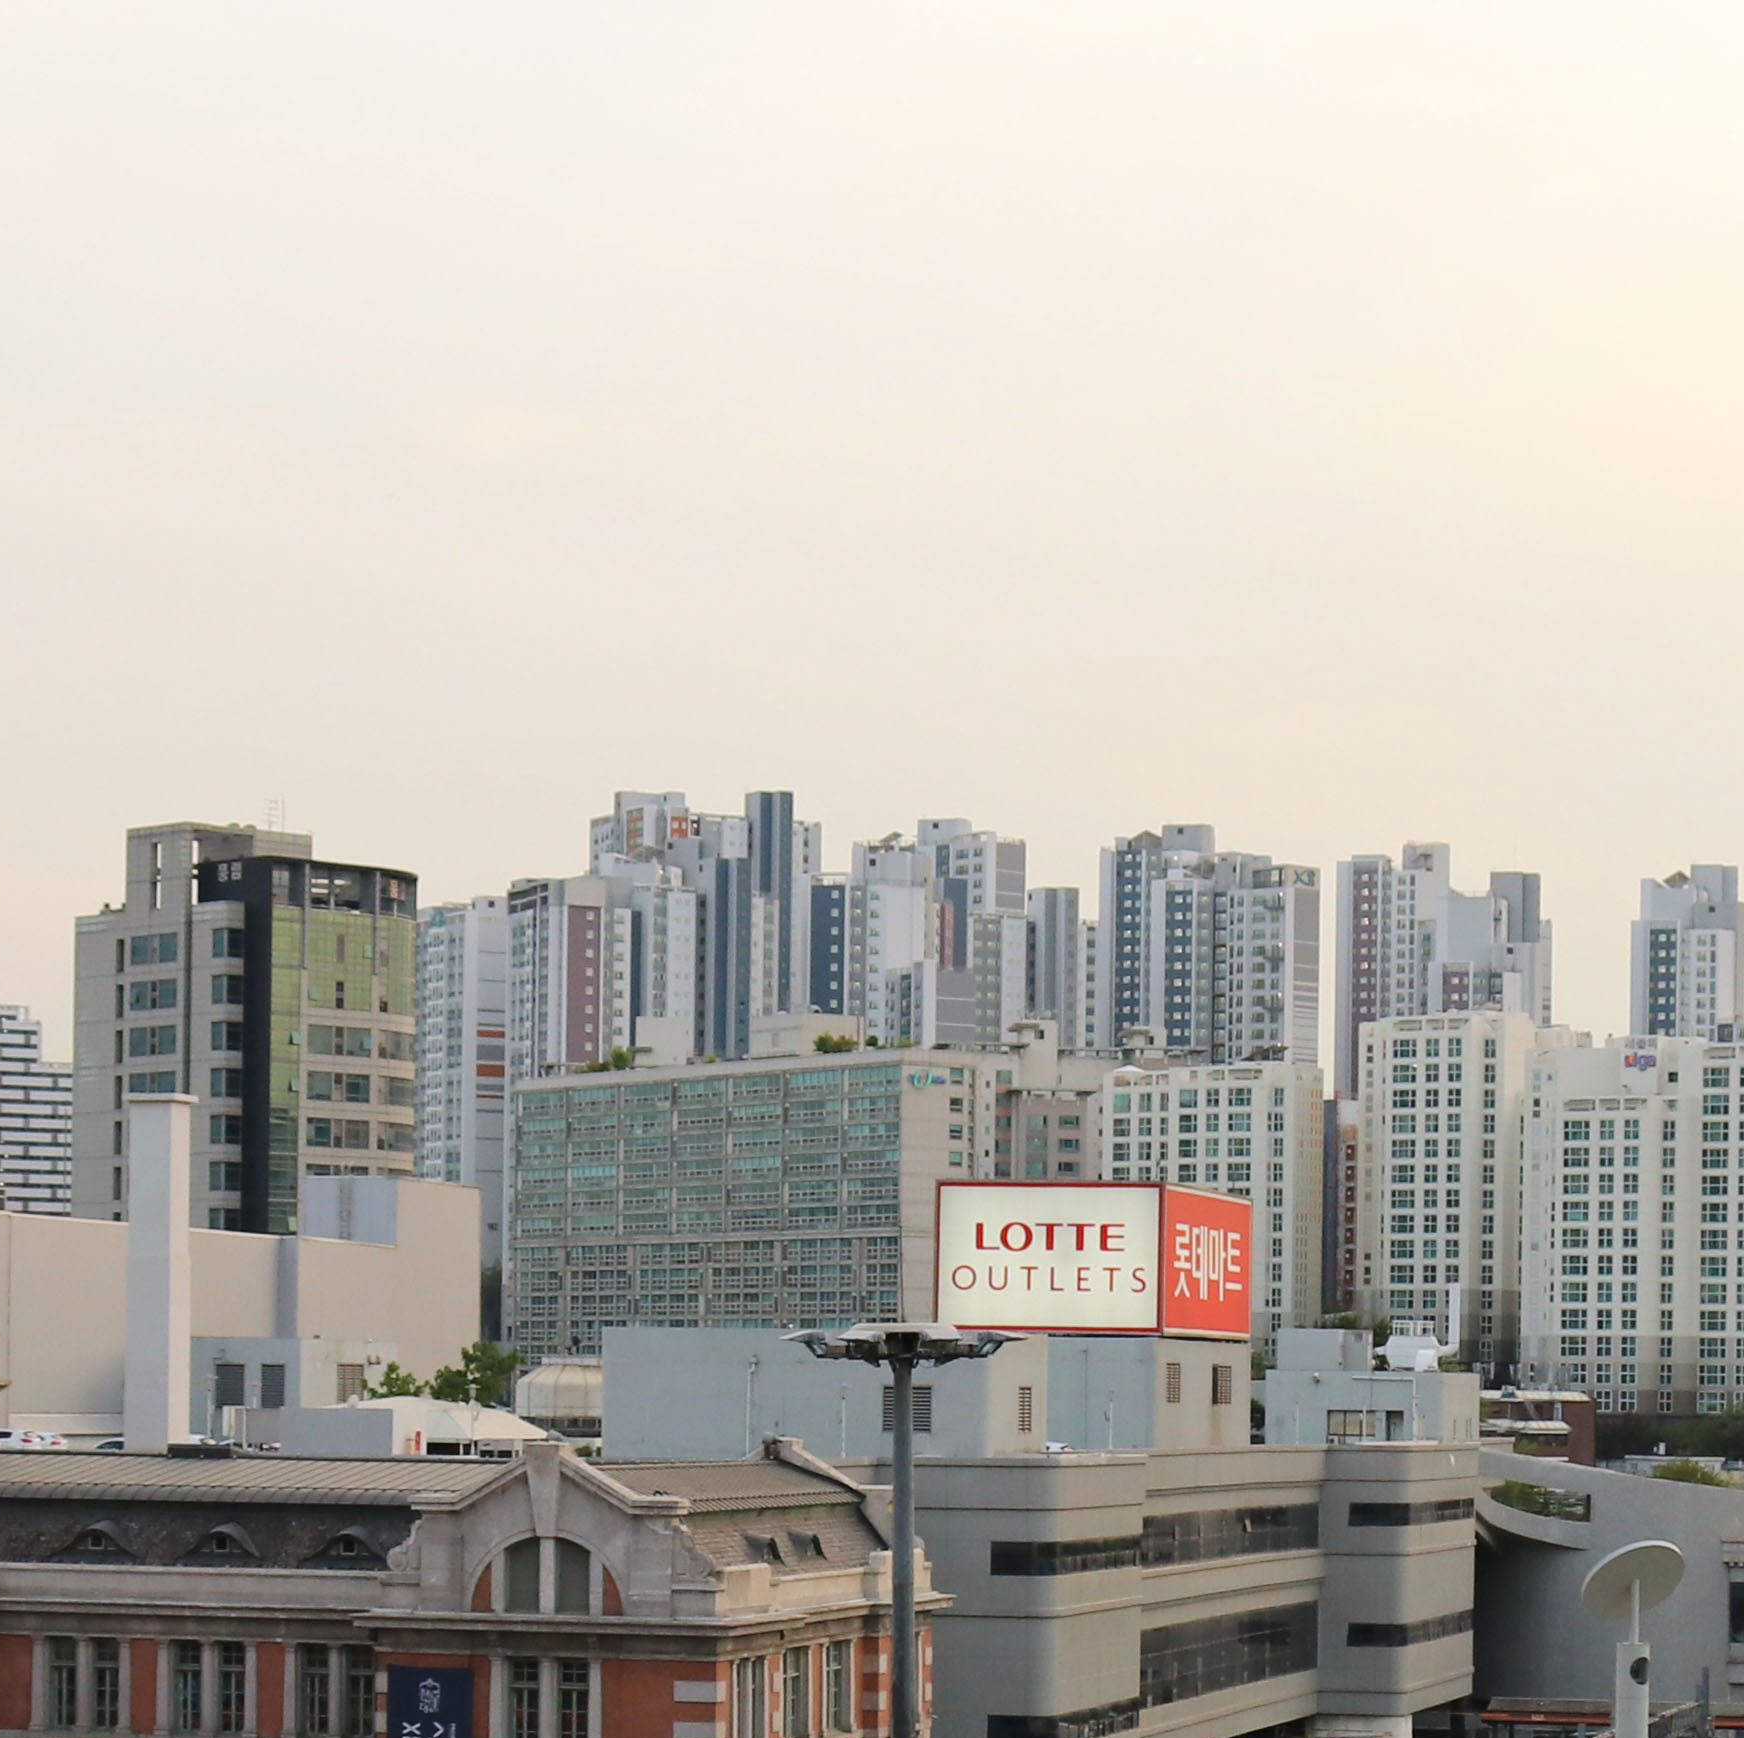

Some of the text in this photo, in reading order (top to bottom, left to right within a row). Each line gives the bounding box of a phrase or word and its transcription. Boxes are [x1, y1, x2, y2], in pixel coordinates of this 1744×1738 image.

[975, 1222, 1125, 1251] LOTTE
[1173, 1222, 1243, 1302] 롯데마트
[952, 1264, 1147, 1293] OUTLETS
